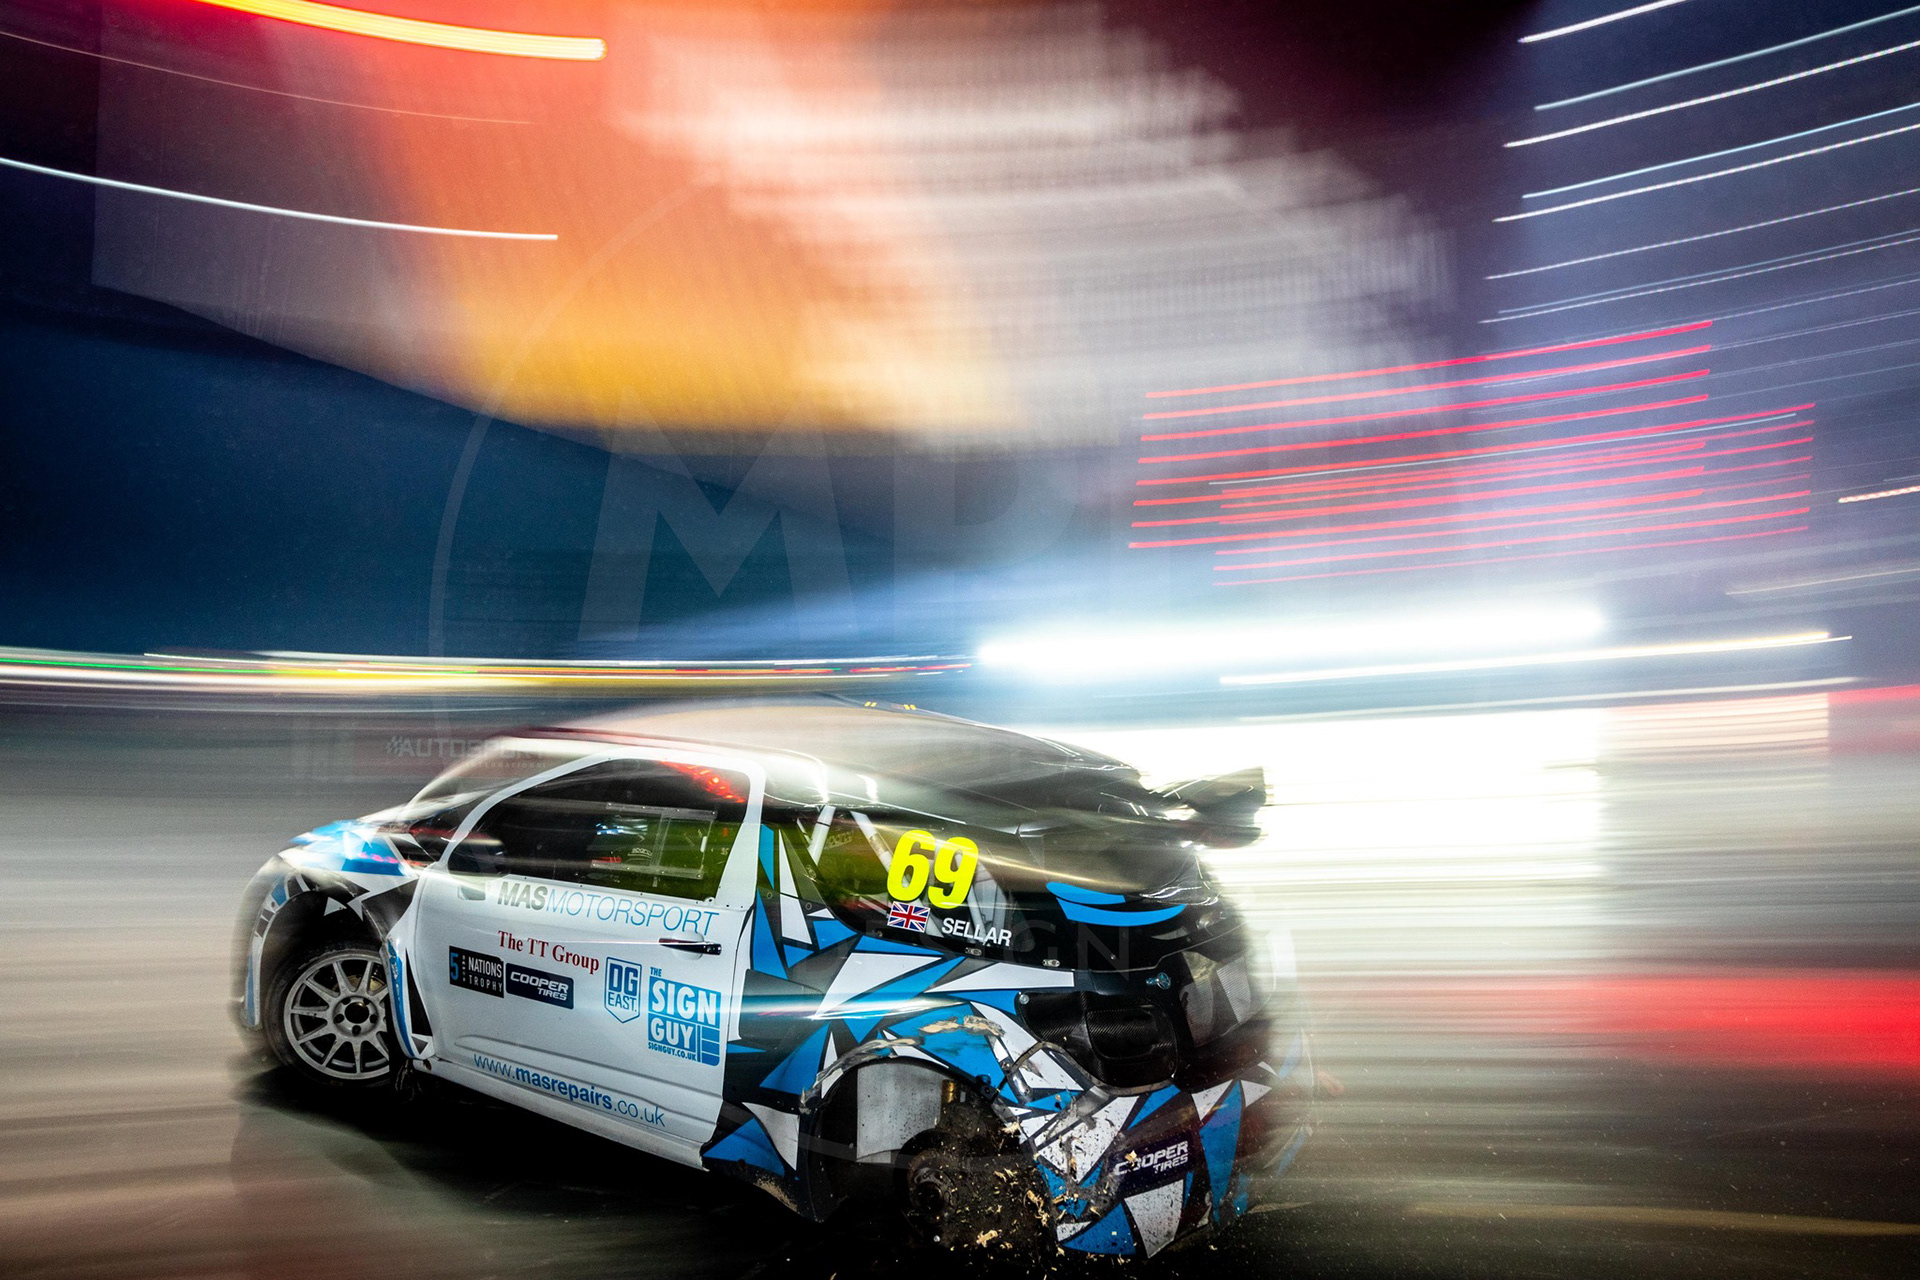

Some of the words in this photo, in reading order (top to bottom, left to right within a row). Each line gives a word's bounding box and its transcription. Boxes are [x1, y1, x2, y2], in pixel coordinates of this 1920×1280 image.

[887, 829, 979, 909] 69
[941, 917, 1012, 947] SELLAR
[450, 952, 459, 981] 5
[497, 930, 523, 951] The
[527, 938, 549, 958] TT
[552, 944, 600, 975] Group
[468, 956, 503, 979] NATIONS
[510, 971, 569, 993] COOPER
[608, 963, 639, 997] DG
[650, 966, 662, 977] THE
[468, 974, 503, 993] TROPHY
[537, 987, 568, 1001] TIRES
[651, 980, 717, 1026] SIGN
[650, 1017, 695, 1049] GUY
[648, 1041, 697, 1062] SIGNGUY.CO.UK
[473, 1053, 666, 1128] www.masrepairs.co.uk
[1152, 1153, 1188, 1174] TIRES
